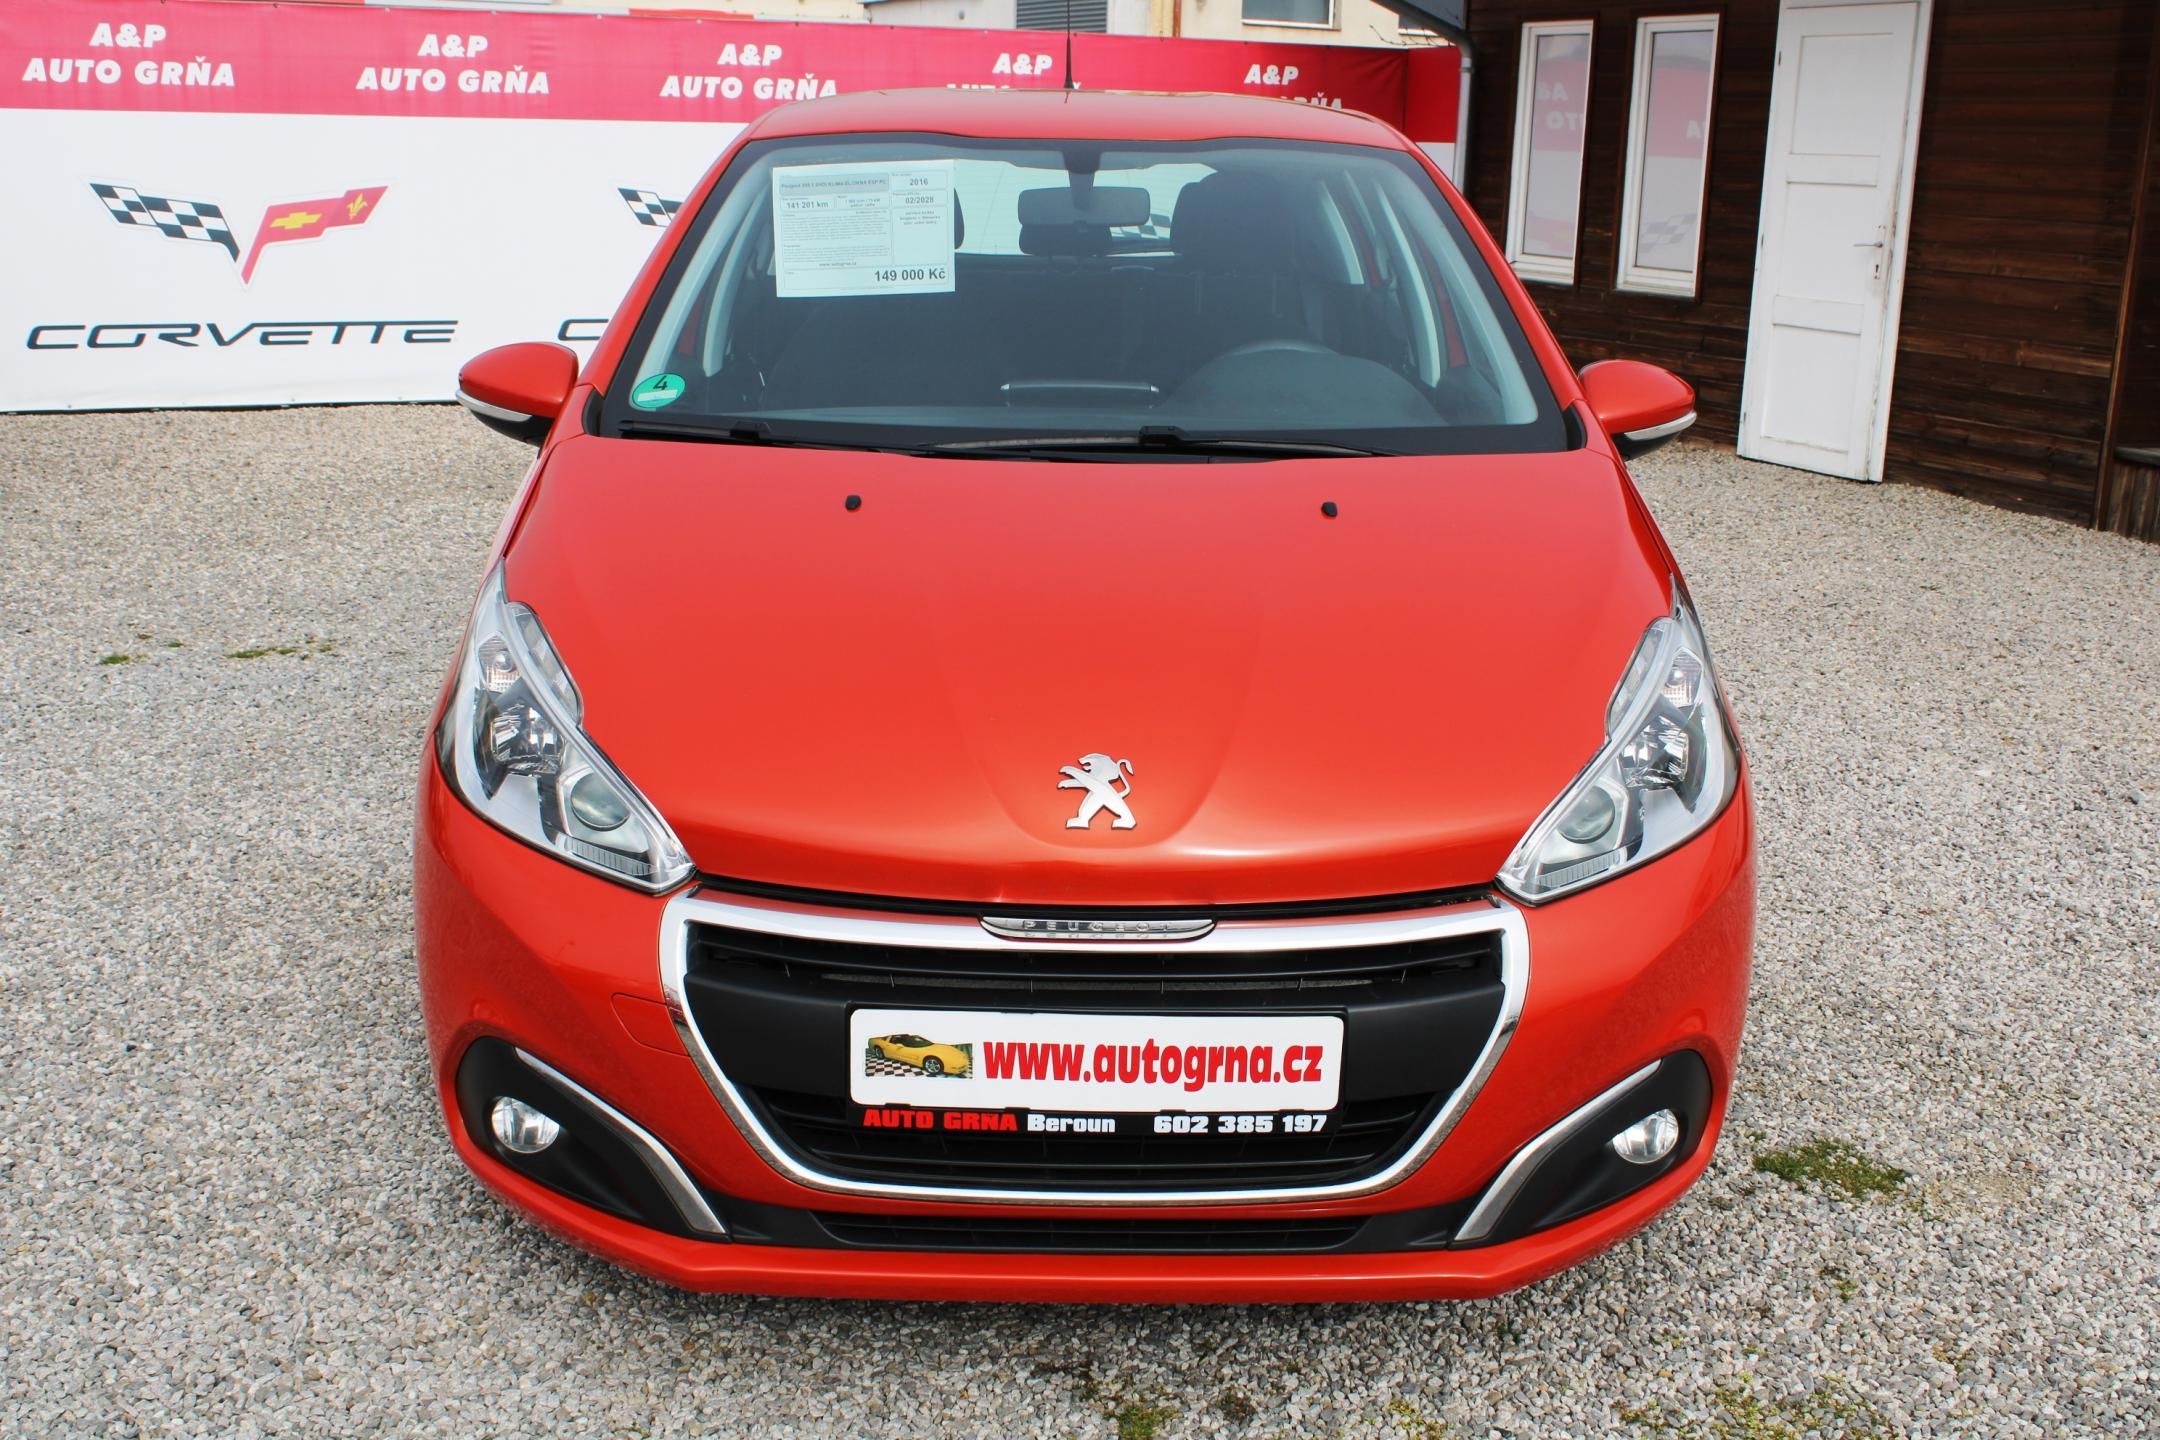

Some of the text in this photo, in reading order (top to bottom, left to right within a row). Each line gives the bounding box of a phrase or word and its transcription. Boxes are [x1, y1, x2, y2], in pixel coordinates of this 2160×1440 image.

[89, 23, 167, 48] A&P
[417, 34, 488, 58] A&P
[717, 43, 783, 67] A&P
[992, 53, 1053, 75] A&P
[22, 56, 235, 86] AUTO GRŇA
[355, 65, 550, 94] AUTO GRŇA
[1244, 64, 1299, 85] A&P
[659, 73, 838, 100] AUTO GRŇA
[909, 178, 929, 186] 2016
[801, 201, 816, 209] 201
[816, 200, 829, 208] km
[874, 267, 946, 282] 149 000 Kč
[27, 320, 458, 350] CORVETTE
[653, 375, 668, 390] 4
[983, 1038, 1323, 1092] www.autogrna.cz
[863, 1109, 934, 1129] AUTO
[1027, 1114, 1116, 1133] Beroun
[1153, 1115, 1209, 1134] 602
[1217, 1115, 1274, 1134] 385
[1282, 1114, 1328, 1133] 197
